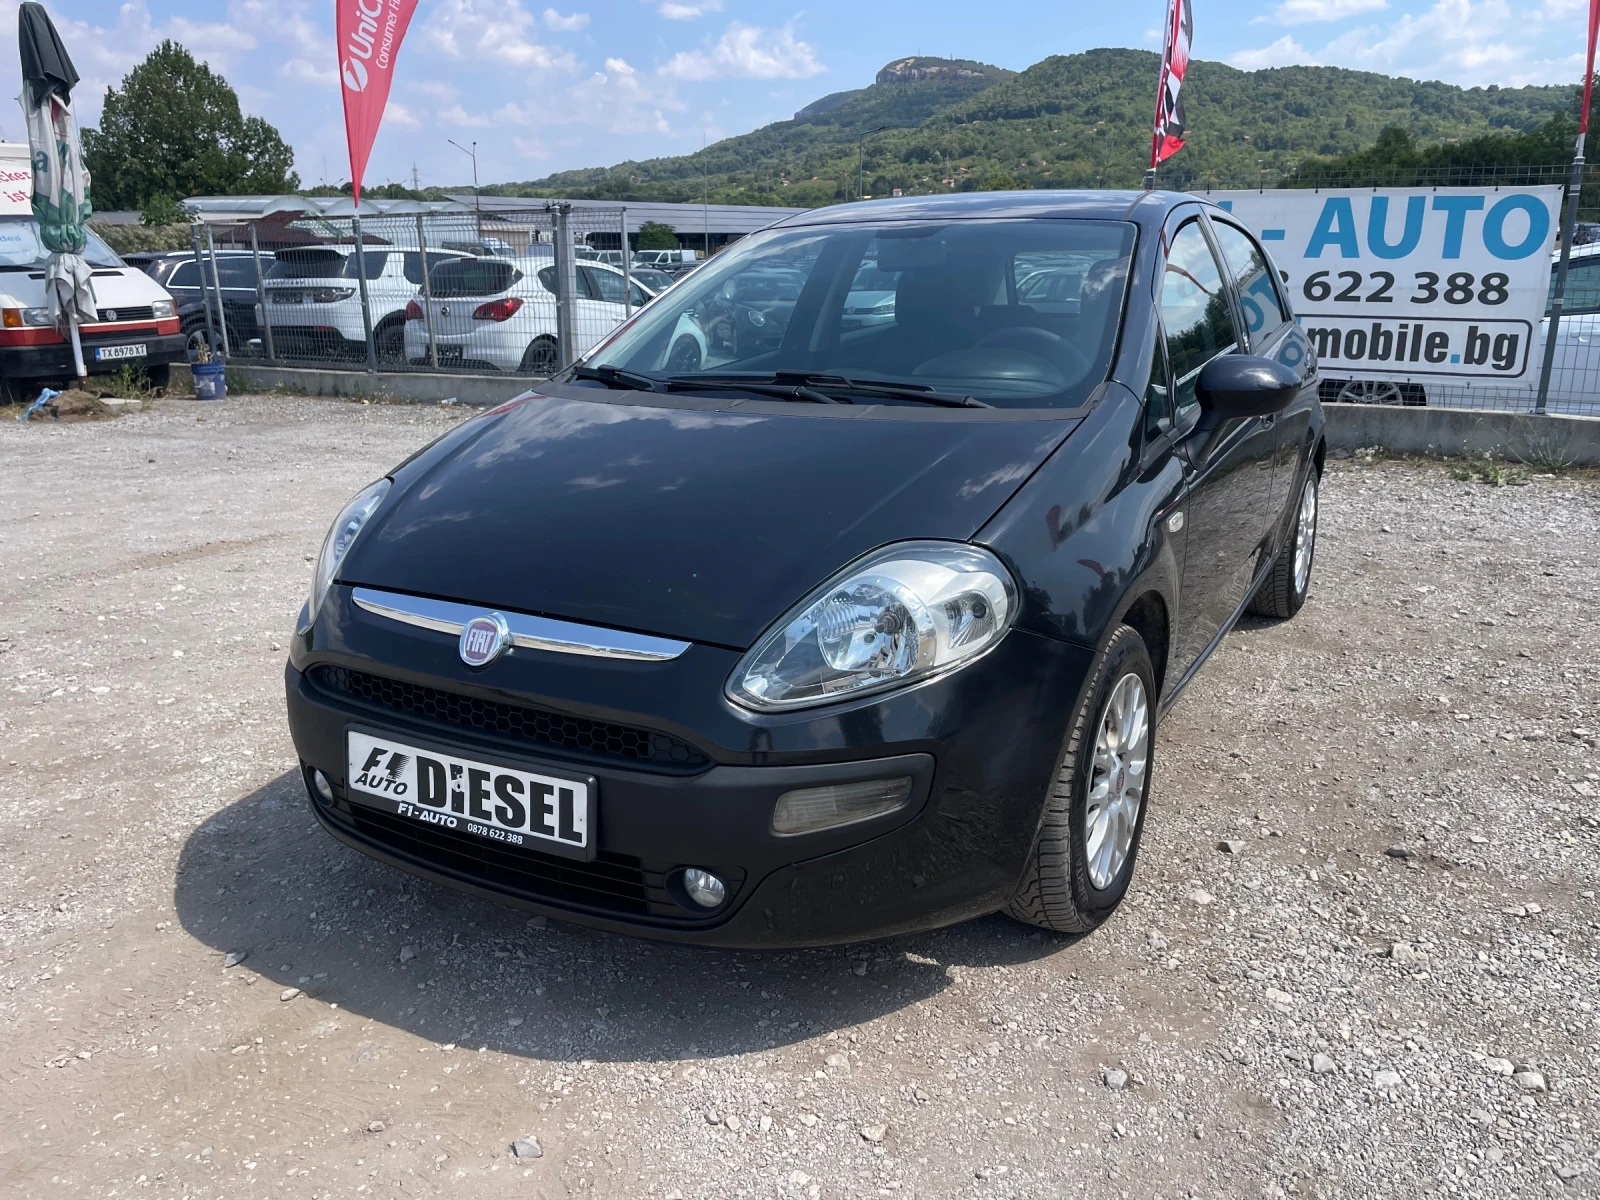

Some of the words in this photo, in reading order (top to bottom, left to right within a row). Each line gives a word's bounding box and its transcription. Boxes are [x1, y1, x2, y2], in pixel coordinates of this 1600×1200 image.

[349, 0, 383, 60] UniC
[375, 9, 398, 69] Consumer
[0, 170, 31, 183] cker
[2, 189, 31, 203] ist
[1303, 193, 1551, 261] AUTO
[1303, 270, 1395, 303] 622
[1409, 271, 1510, 306] 388
[101, 348, 114, 358] TX
[114, 347, 134, 357] 8978
[135, 345, 145, 355] XT
[1306, 322, 1520, 371] mobile.bg
[466, 628, 495, 654] FIAT
[353, 772, 408, 796] AUTO
[416, 755, 583, 844] DIESEL
[397, 802, 458, 828] F1-AUTO
[467, 822, 488, 836] 0878
[489, 827, 505, 841] 622
[506, 832, 523, 845] 388
